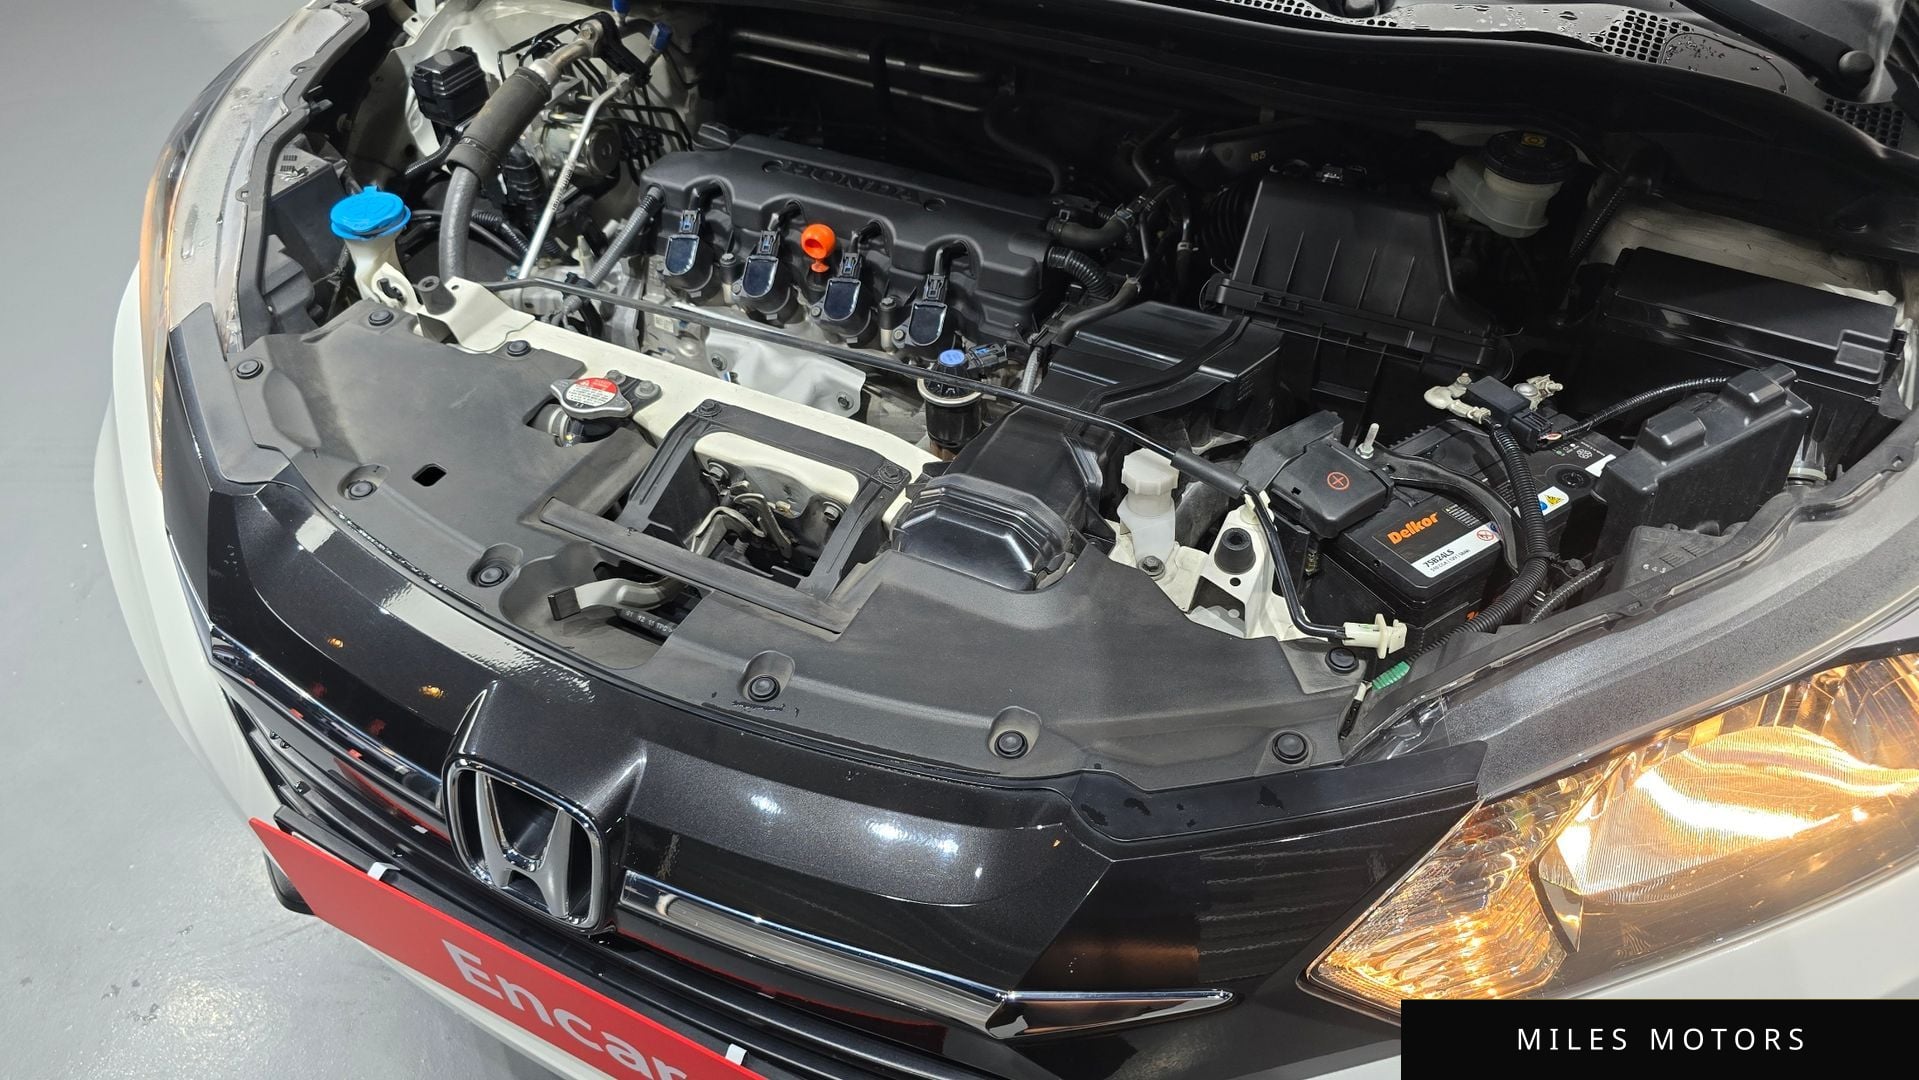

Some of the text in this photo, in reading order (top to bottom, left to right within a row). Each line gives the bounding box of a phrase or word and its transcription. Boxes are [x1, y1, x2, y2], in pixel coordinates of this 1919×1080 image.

[780, 160, 922, 205] HONDA
[1387, 512, 1439, 545] Delkor
[1423, 549, 1455, 568] 75B24LS
[441, 938, 688, 1080] Encar
